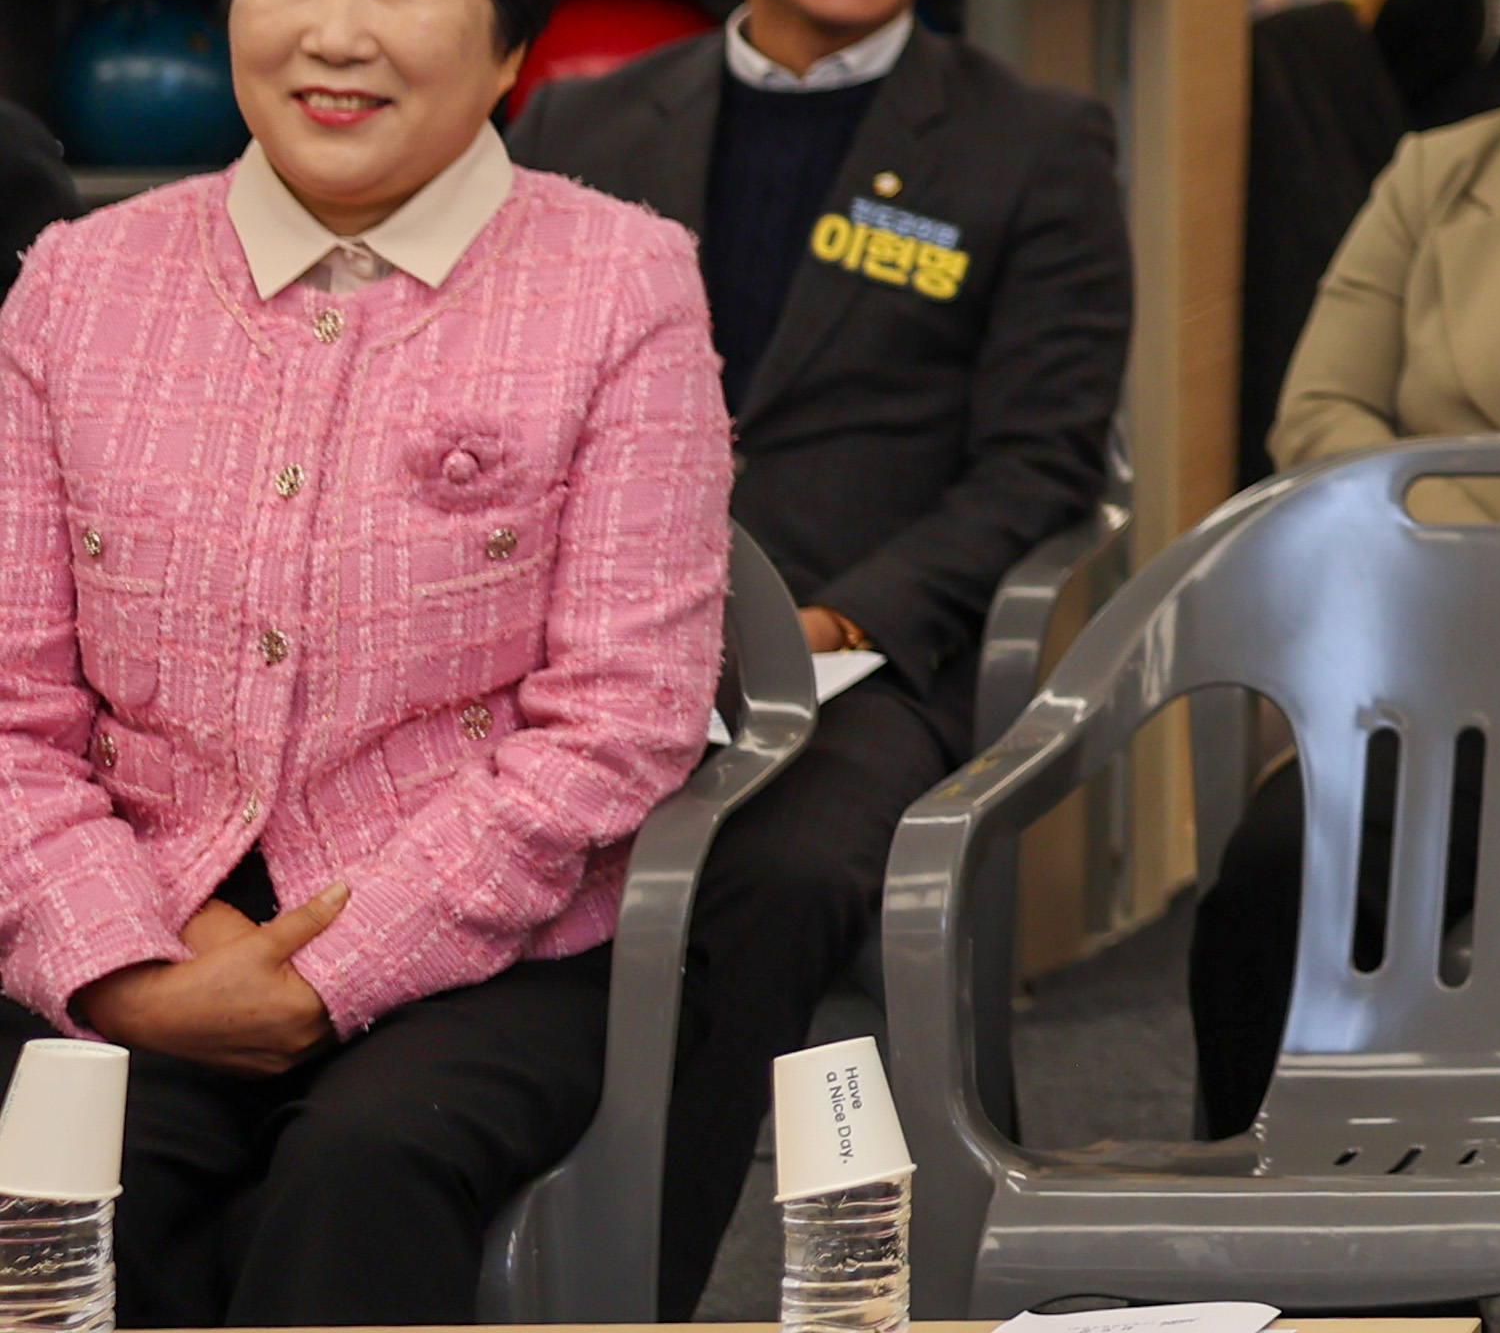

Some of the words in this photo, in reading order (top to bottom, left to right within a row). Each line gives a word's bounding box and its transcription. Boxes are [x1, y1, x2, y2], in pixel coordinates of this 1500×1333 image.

[826, 1071, 838, 1083] a
[844, 1065, 863, 1110] Have
[828, 1085, 846, 1123] Nice
[837, 1125, 854, 1164] Day.
